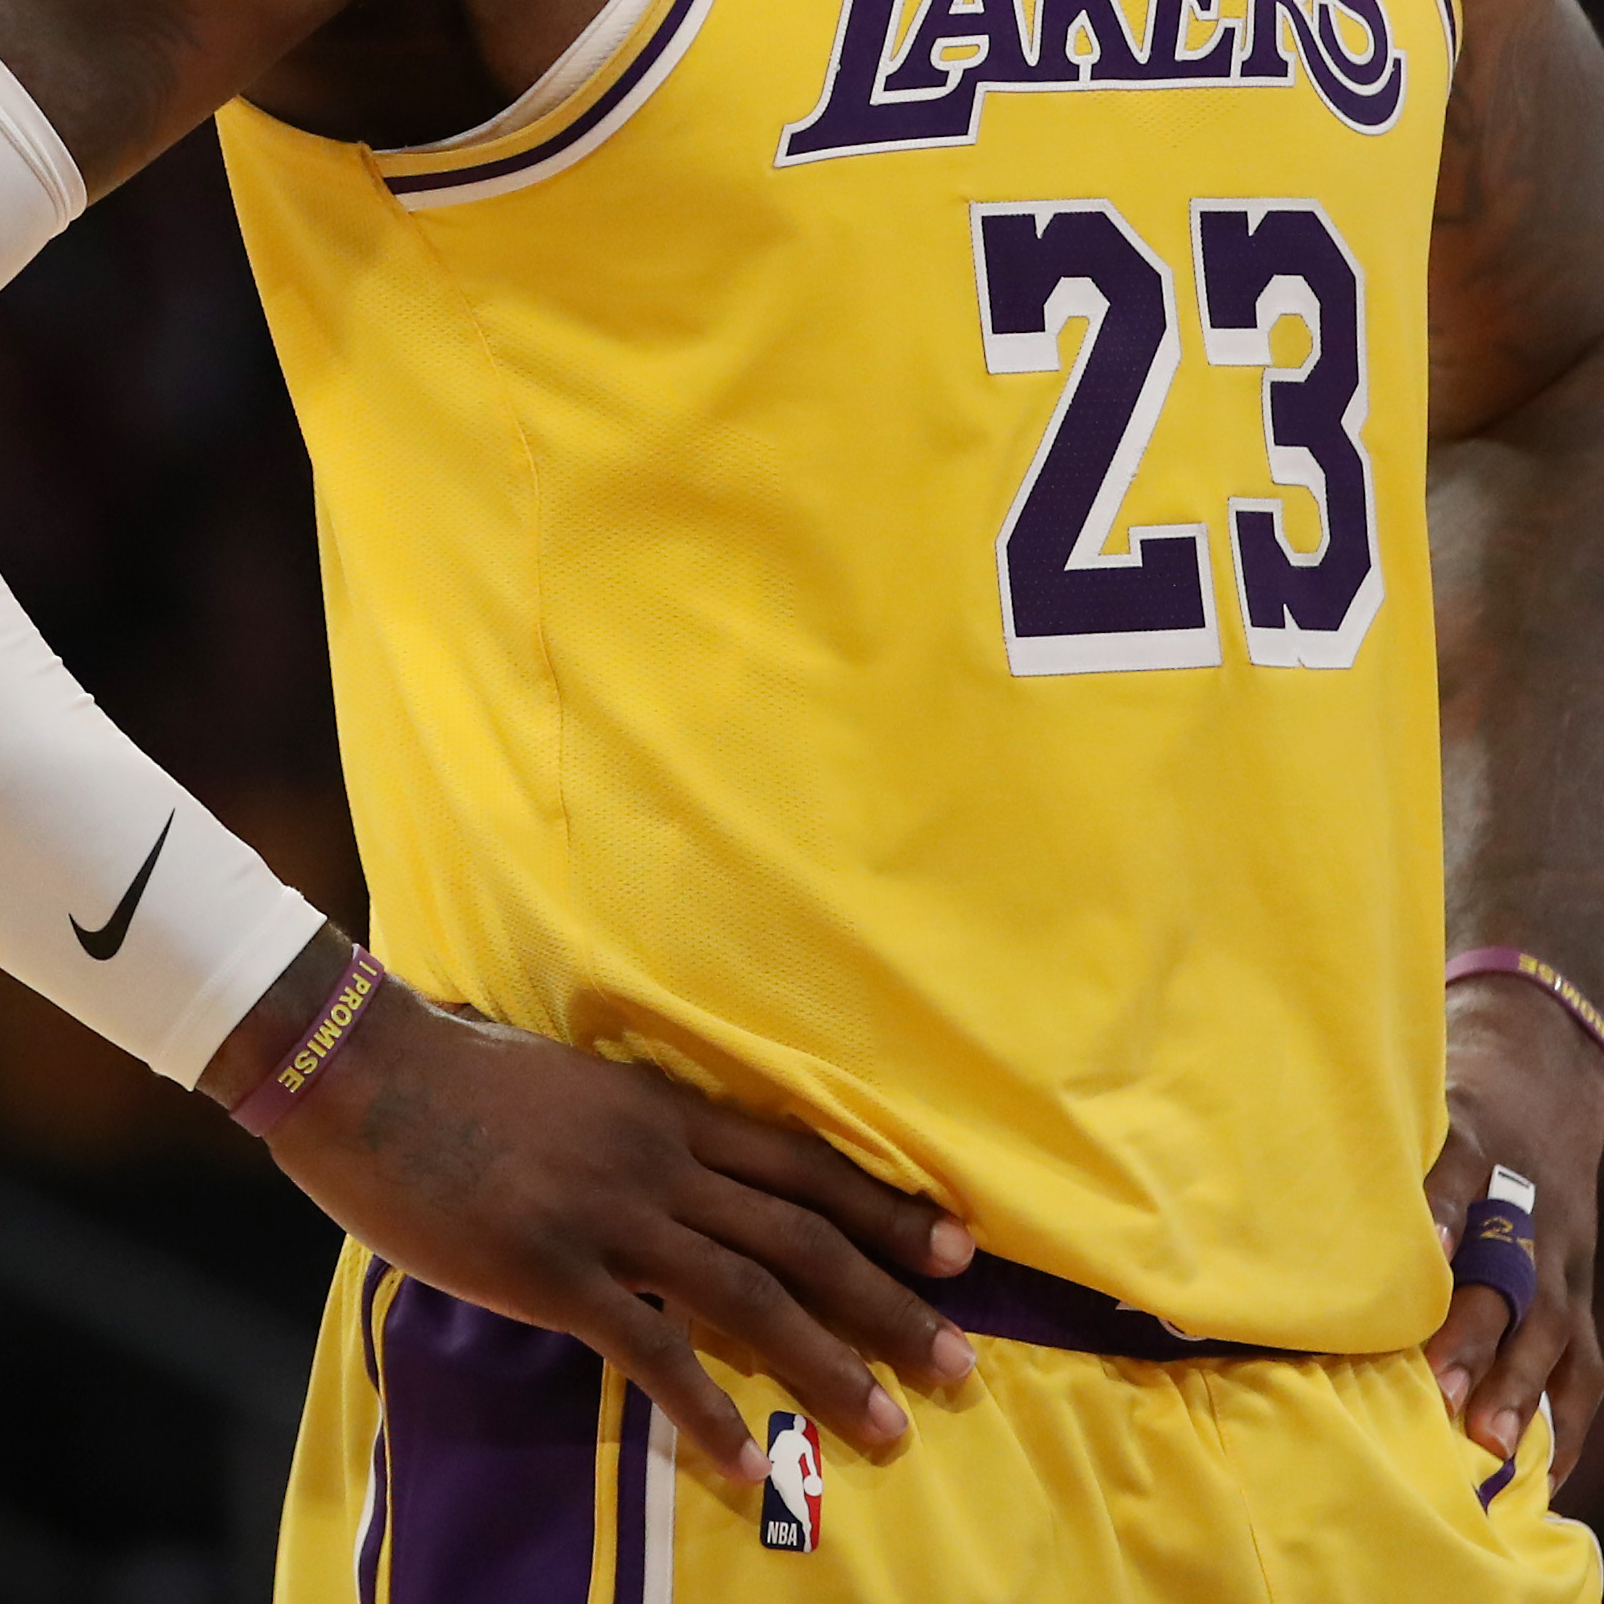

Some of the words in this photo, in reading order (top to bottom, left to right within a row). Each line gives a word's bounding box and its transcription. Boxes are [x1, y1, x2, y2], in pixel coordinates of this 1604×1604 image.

[969, 197, 1385, 677] 23
[359, 960, 378, 977] I
[277, 972, 372, 1093] PROMISE
[767, 1521, 798, 1546] NBA
